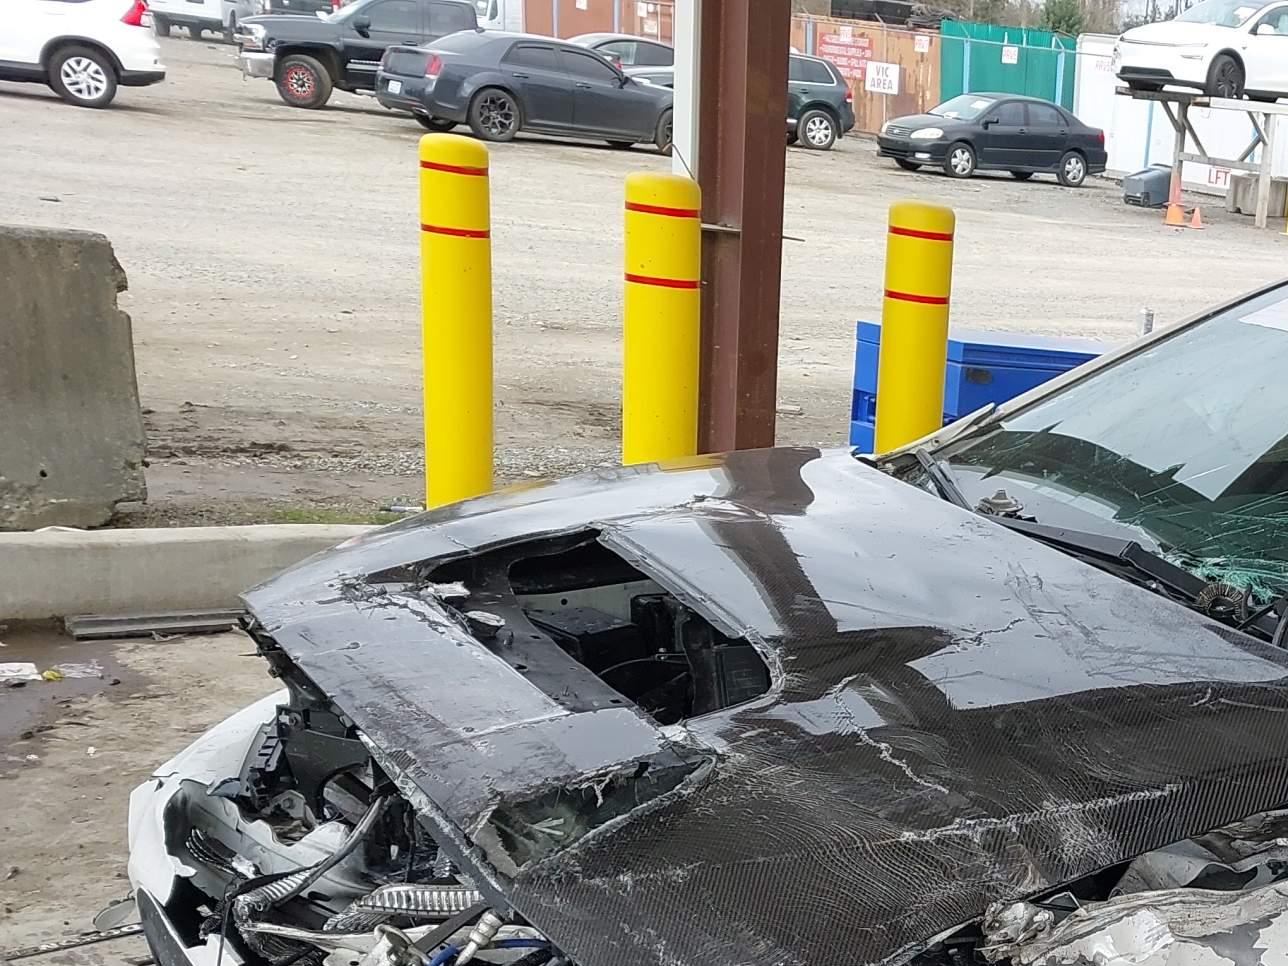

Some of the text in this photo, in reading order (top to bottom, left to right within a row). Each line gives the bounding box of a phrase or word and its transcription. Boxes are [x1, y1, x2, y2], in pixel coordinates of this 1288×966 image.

[875, 64, 890, 78] VIC
[870, 77, 893, 90] AREA
[1208, 168, 1230, 186] LFT
